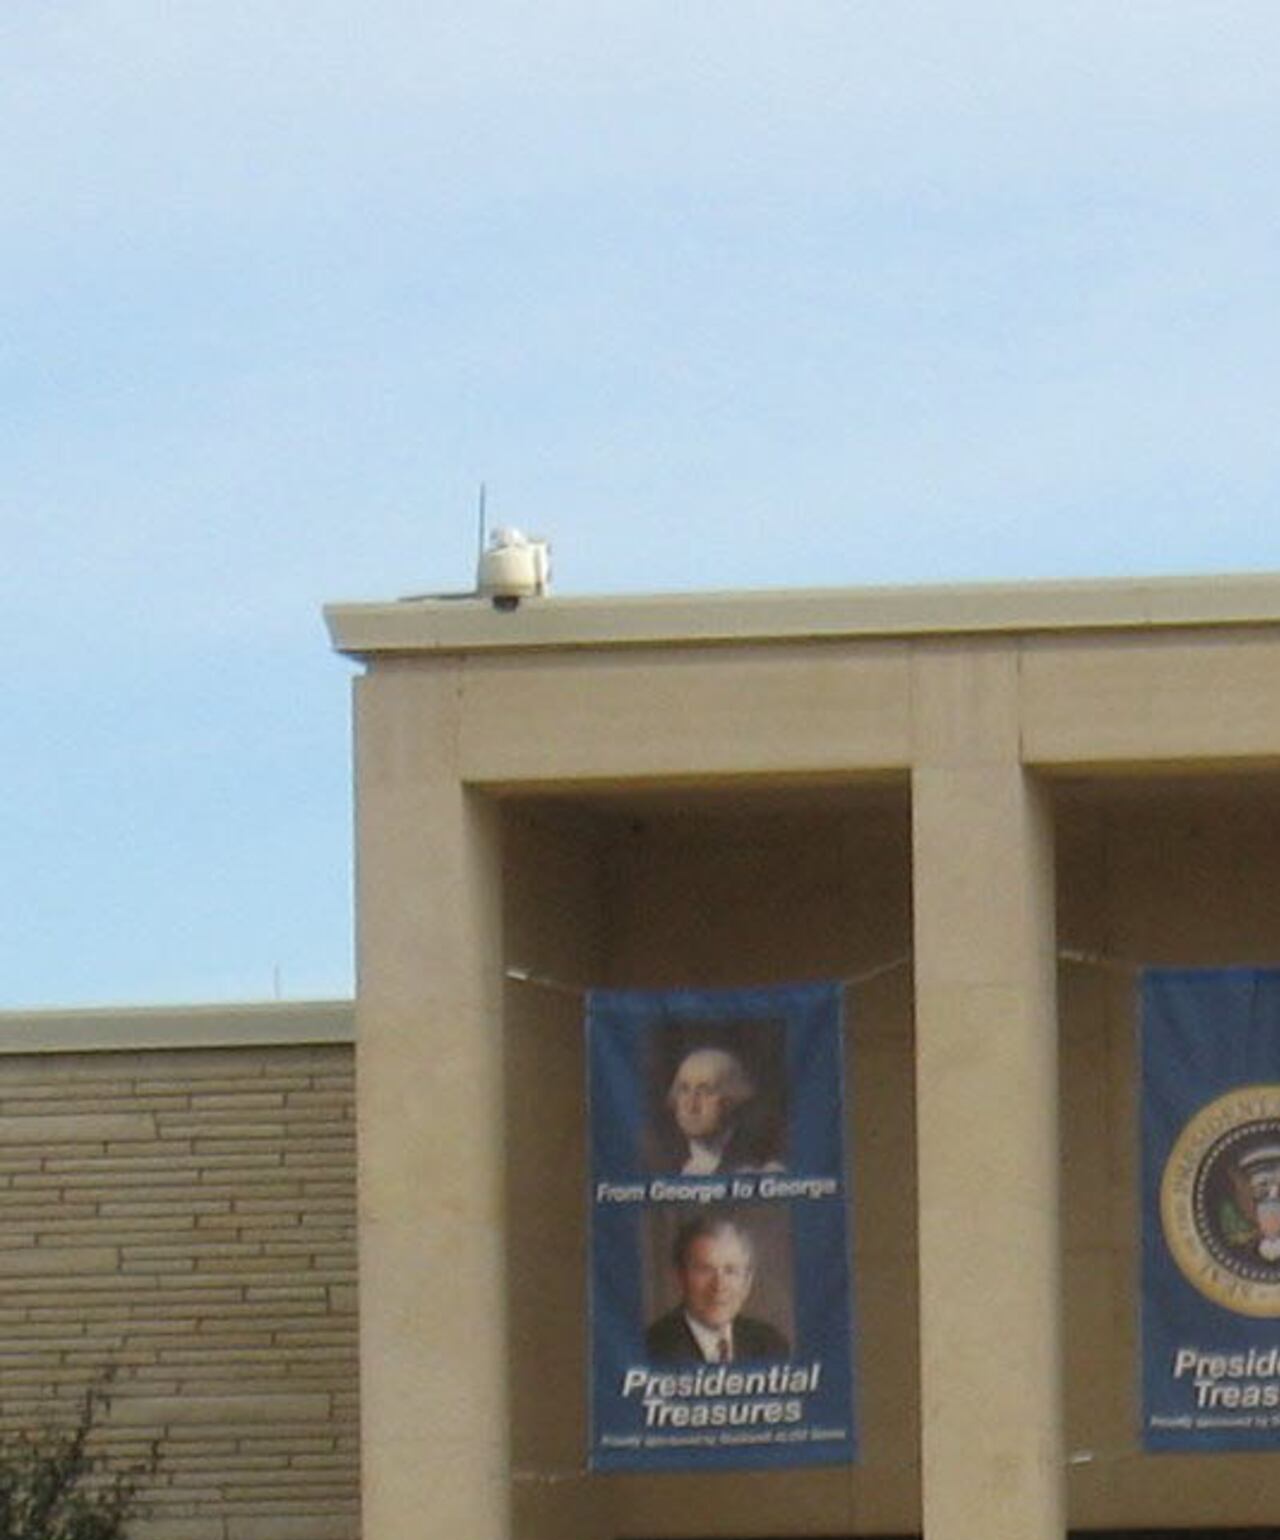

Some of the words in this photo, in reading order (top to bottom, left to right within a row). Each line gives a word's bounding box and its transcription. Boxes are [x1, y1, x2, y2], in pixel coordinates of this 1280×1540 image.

[597, 1182, 645, 1202] From
[649, 1179, 727, 1202] George
[732, 1179, 753, 1199] to
[759, 1177, 837, 1199] George
[622, 1363, 820, 1399] Presidential
[641, 1398, 802, 1427] Treasures
